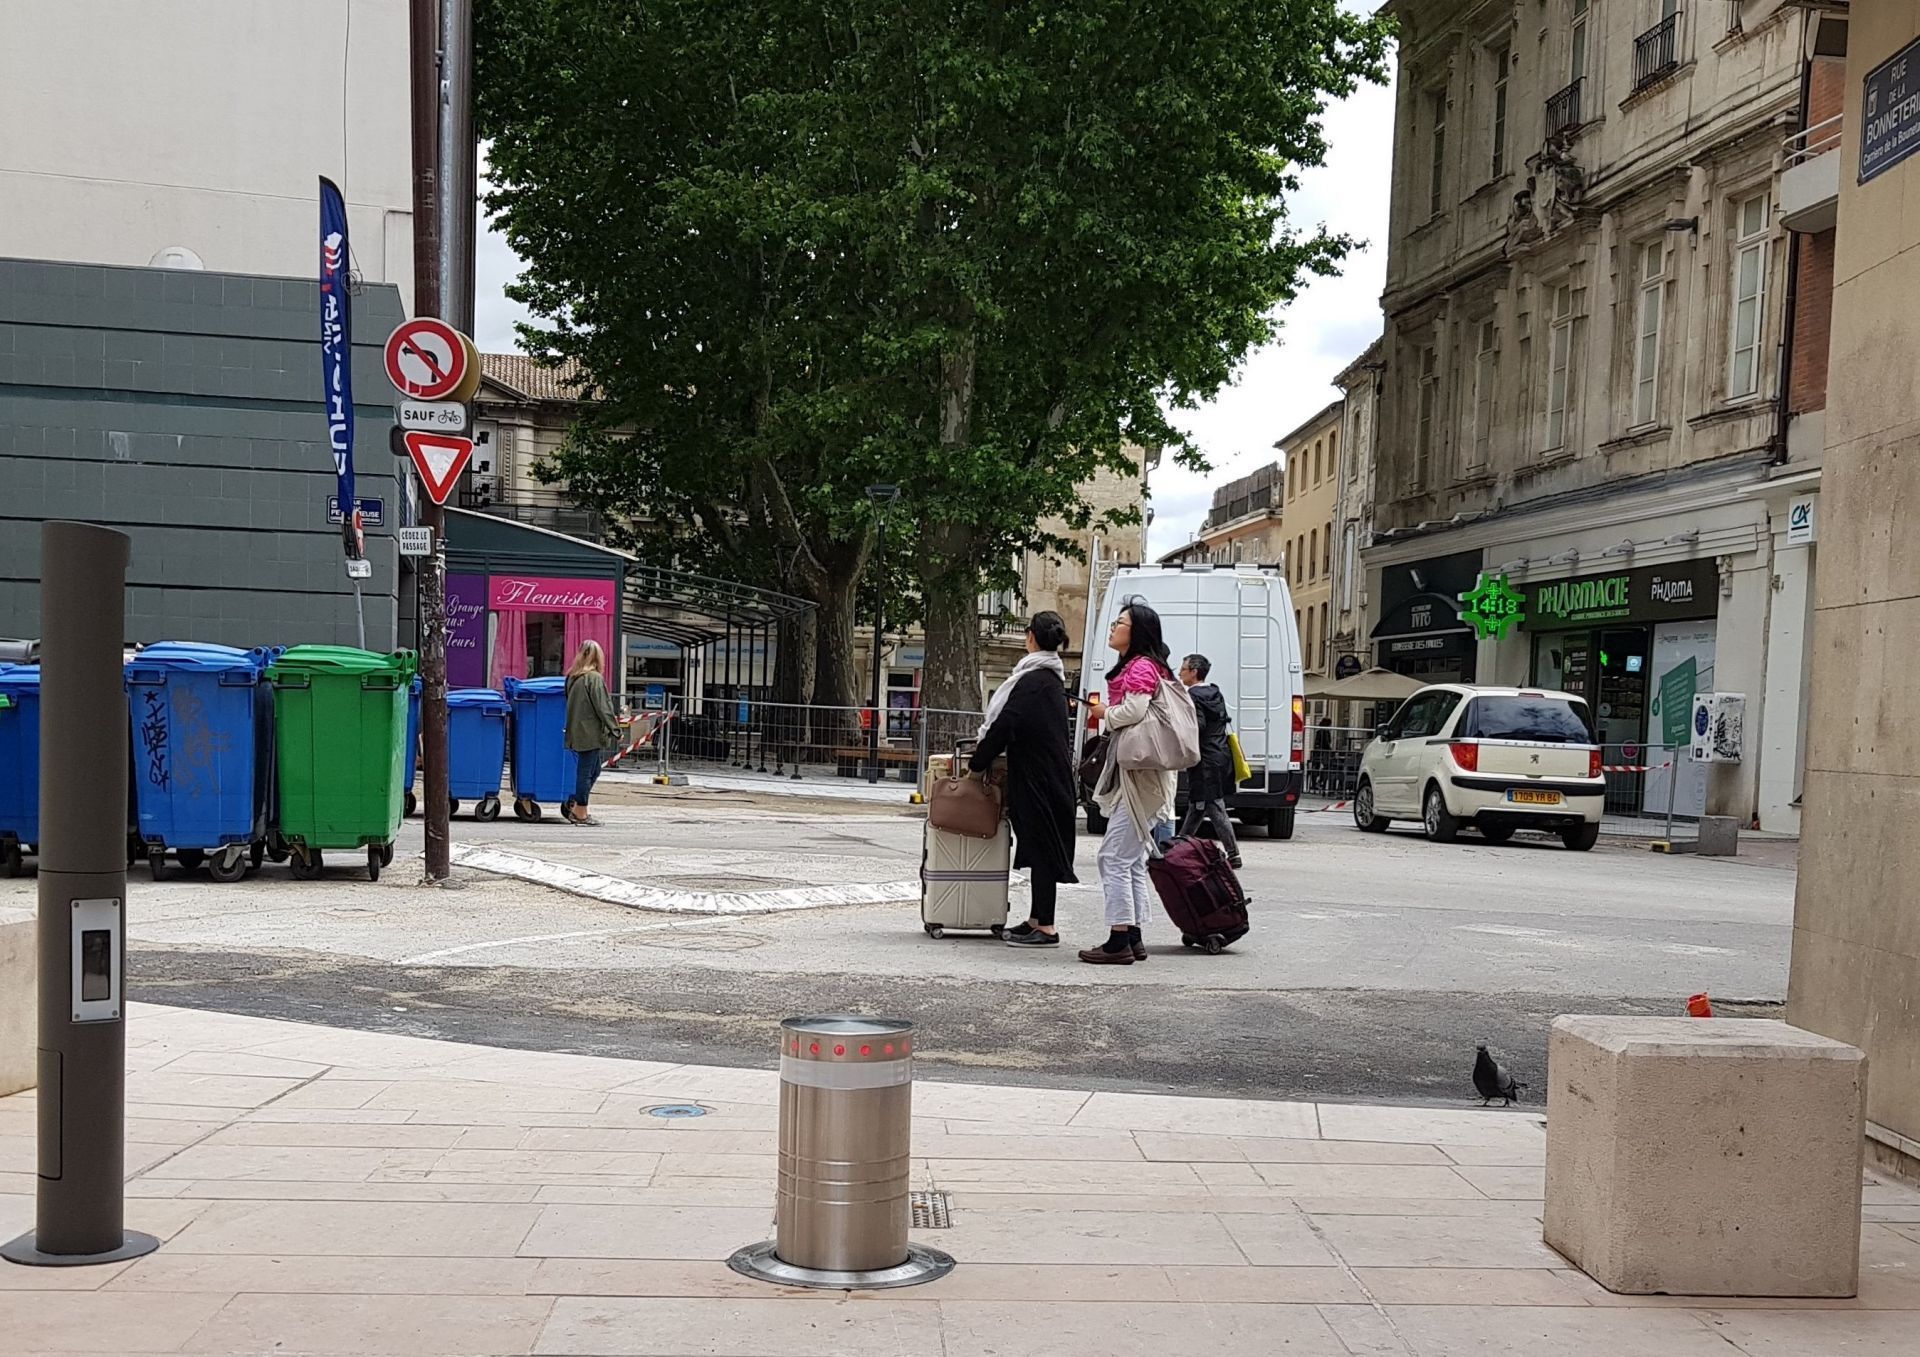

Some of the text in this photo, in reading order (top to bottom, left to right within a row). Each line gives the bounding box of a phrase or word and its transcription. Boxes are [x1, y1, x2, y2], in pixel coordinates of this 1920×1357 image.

[1891, 58, 1907, 84] RUE
[1889, 82, 1905, 104] DE LA
[404, 410, 435, 421] SAUF
[401, 530, 428, 540] CÉDEZ LE
[402, 543, 427, 551] PASSAGE
[497, 579, 594, 605] Fleuriste
[1538, 577, 1630, 616] PHARMACIE
[1651, 580, 1693, 601] PHARMA
[446, 595, 485, 619] Grange
[1471, 599, 1518, 614] 14:18
[1514, 792, 1534, 801] 1709
